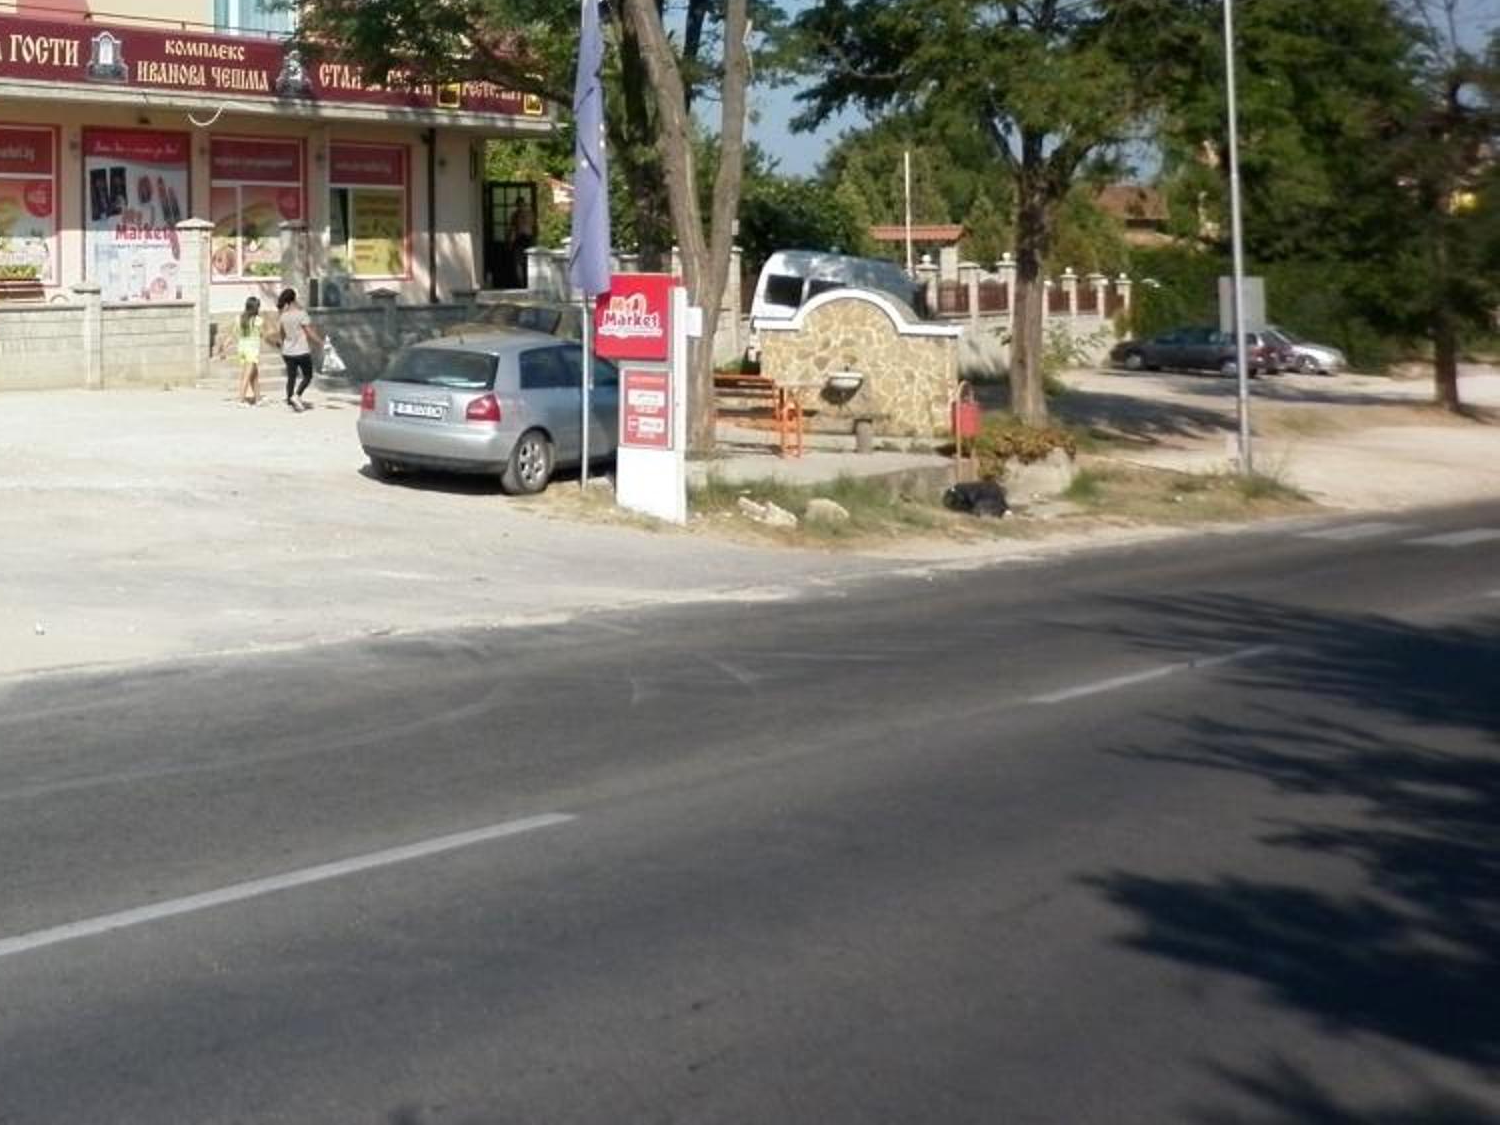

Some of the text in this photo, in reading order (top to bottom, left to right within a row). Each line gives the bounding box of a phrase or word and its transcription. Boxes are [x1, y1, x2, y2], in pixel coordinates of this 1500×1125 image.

[9, 34, 80, 67] ГОСТИ
[164, 39, 245, 62] КОМПЛЕКС
[137, 60, 269, 91] ИВАНОВА ЧЕШМА
[604, 311, 658, 327] Market
